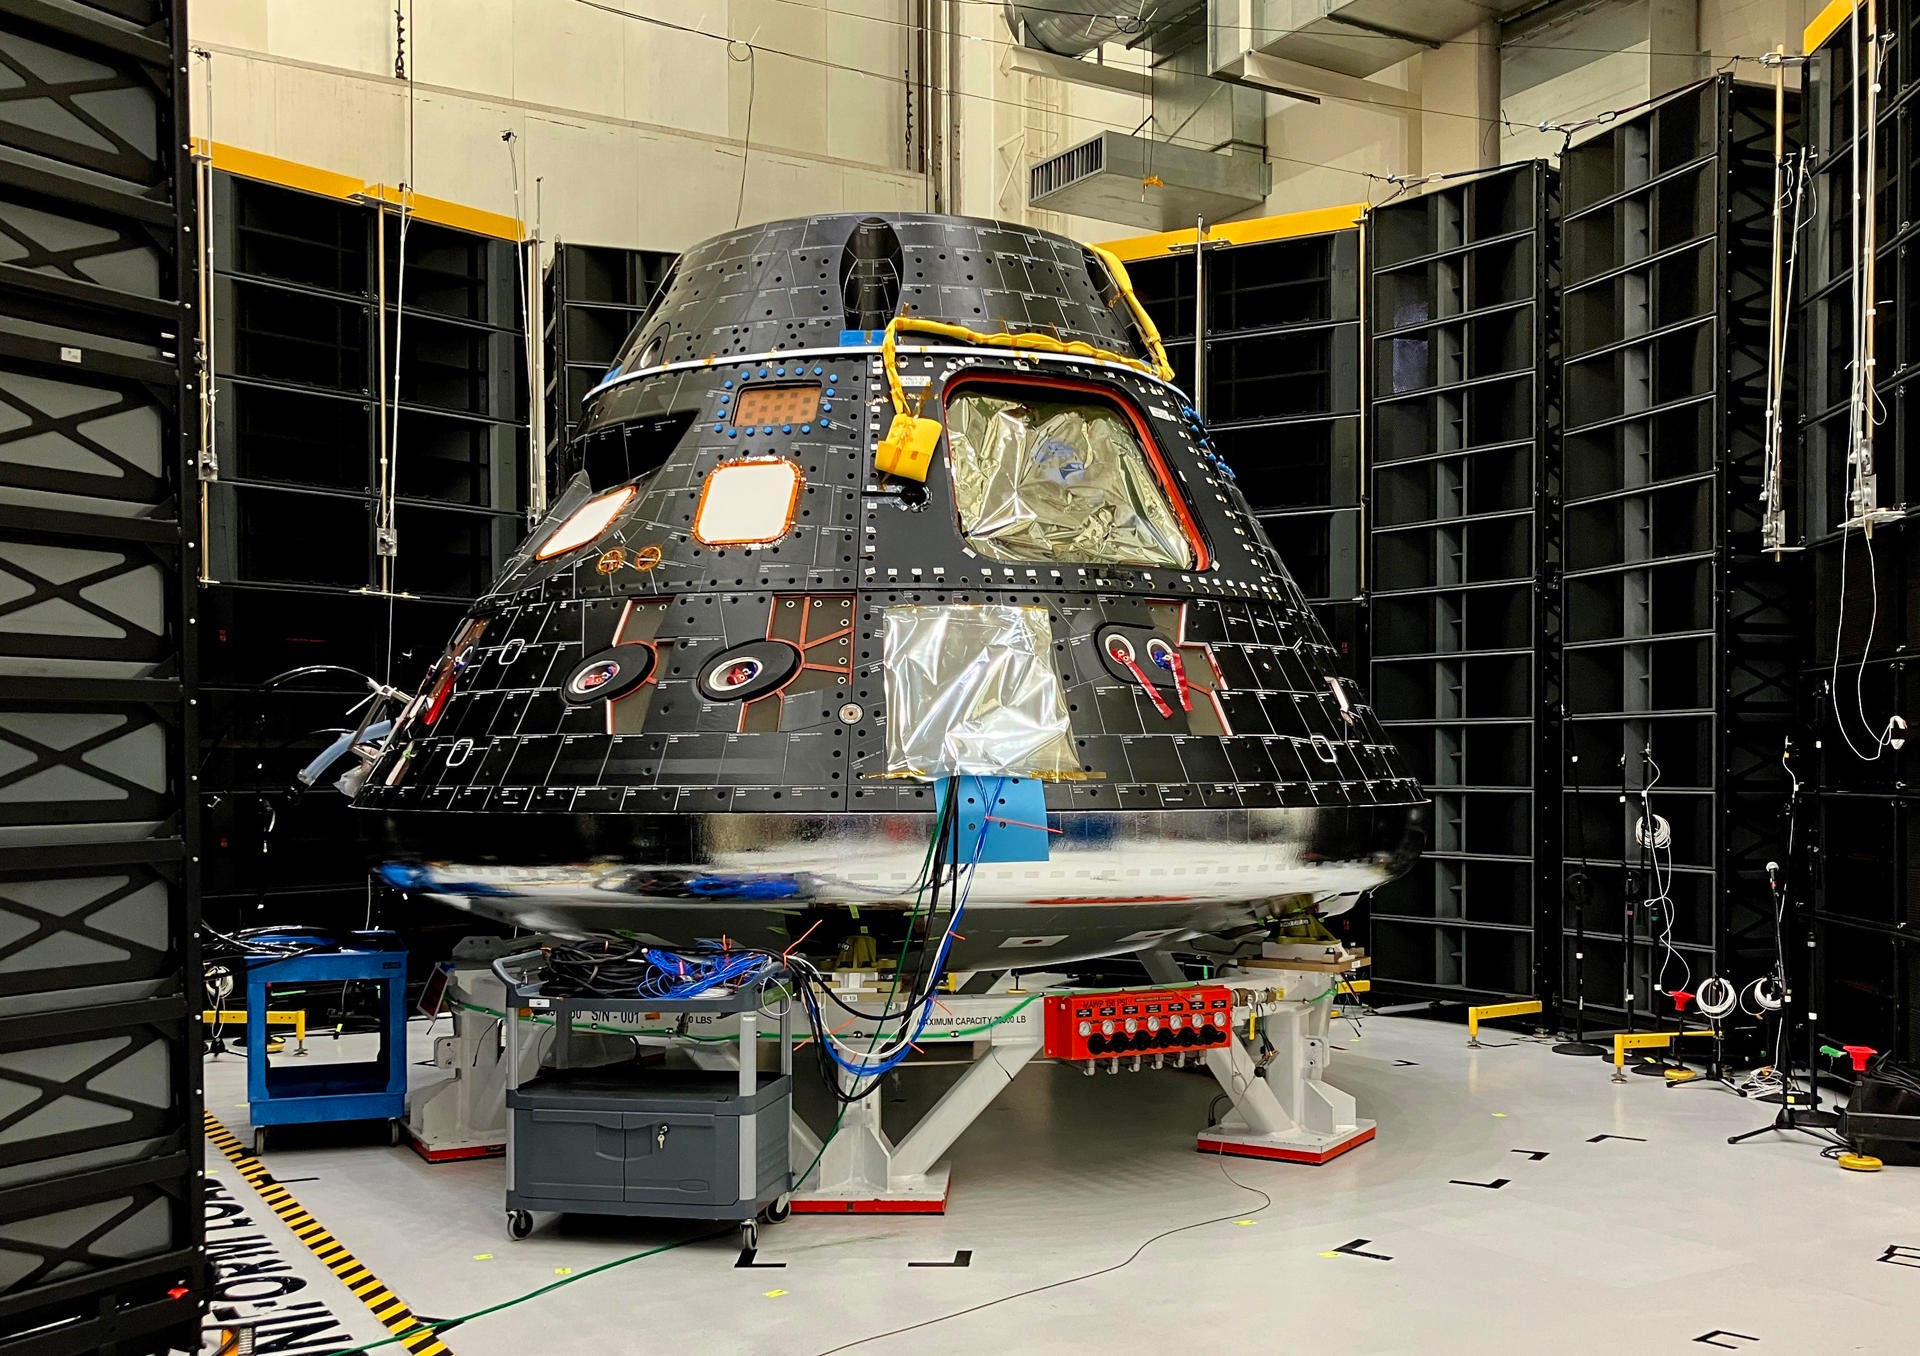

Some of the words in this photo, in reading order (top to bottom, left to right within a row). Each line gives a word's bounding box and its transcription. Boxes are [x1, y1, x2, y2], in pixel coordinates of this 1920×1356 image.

[696, 1016, 712, 1024] LBS
[955, 1016, 993, 1026] CAPACITY
[1016, 1015, 1027, 1024] LB
